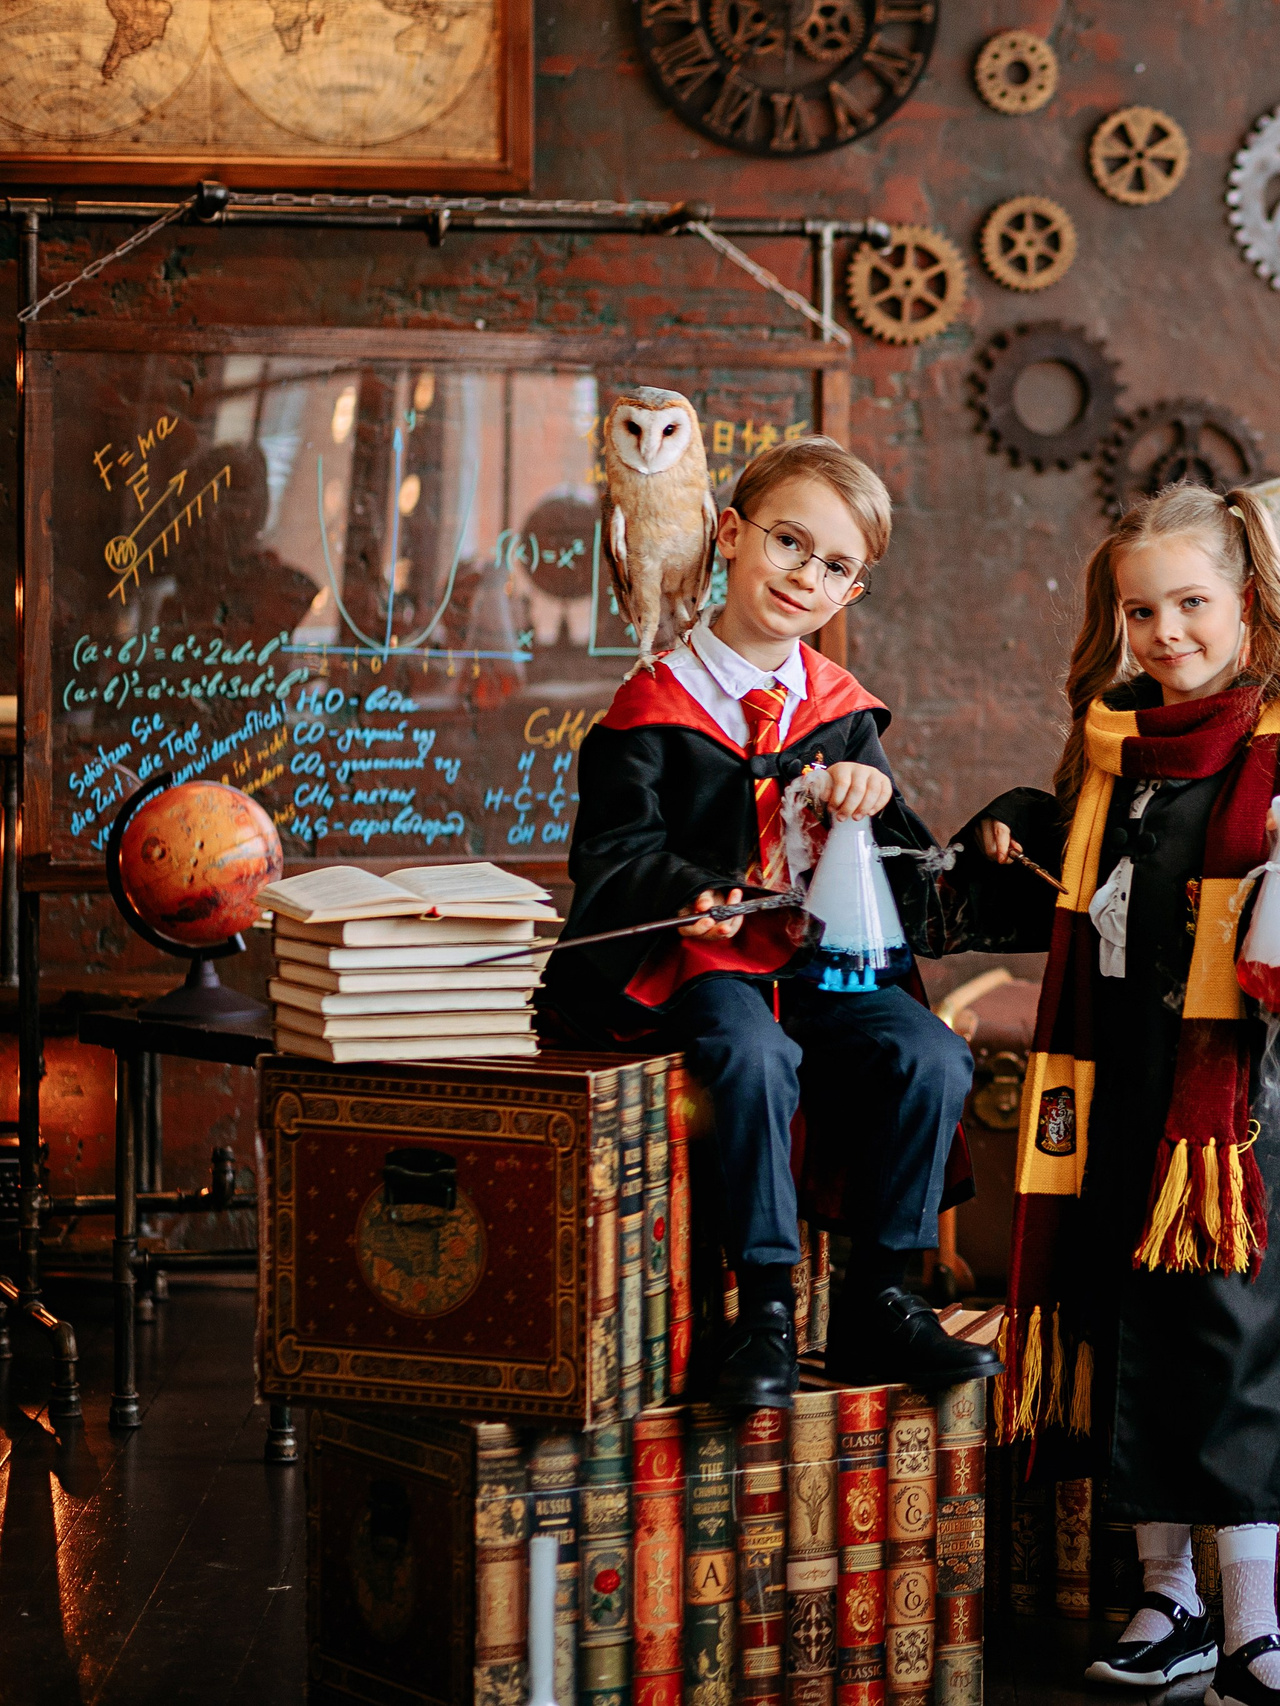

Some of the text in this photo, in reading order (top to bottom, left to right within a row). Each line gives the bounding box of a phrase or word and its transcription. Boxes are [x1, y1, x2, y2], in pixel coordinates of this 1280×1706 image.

[130, 712, 165, 745] Sie
[71, 807, 96, 837] die
[137, 753, 165, 781] die
[158, 721, 201, 760] Tage
[842, 1432, 885, 1449] CLASSIC
[940, 1538, 981, 1555] POEMS
[702, 1561, 722, 1588] A
[841, 1664, 883, 1680] CLASSIC
